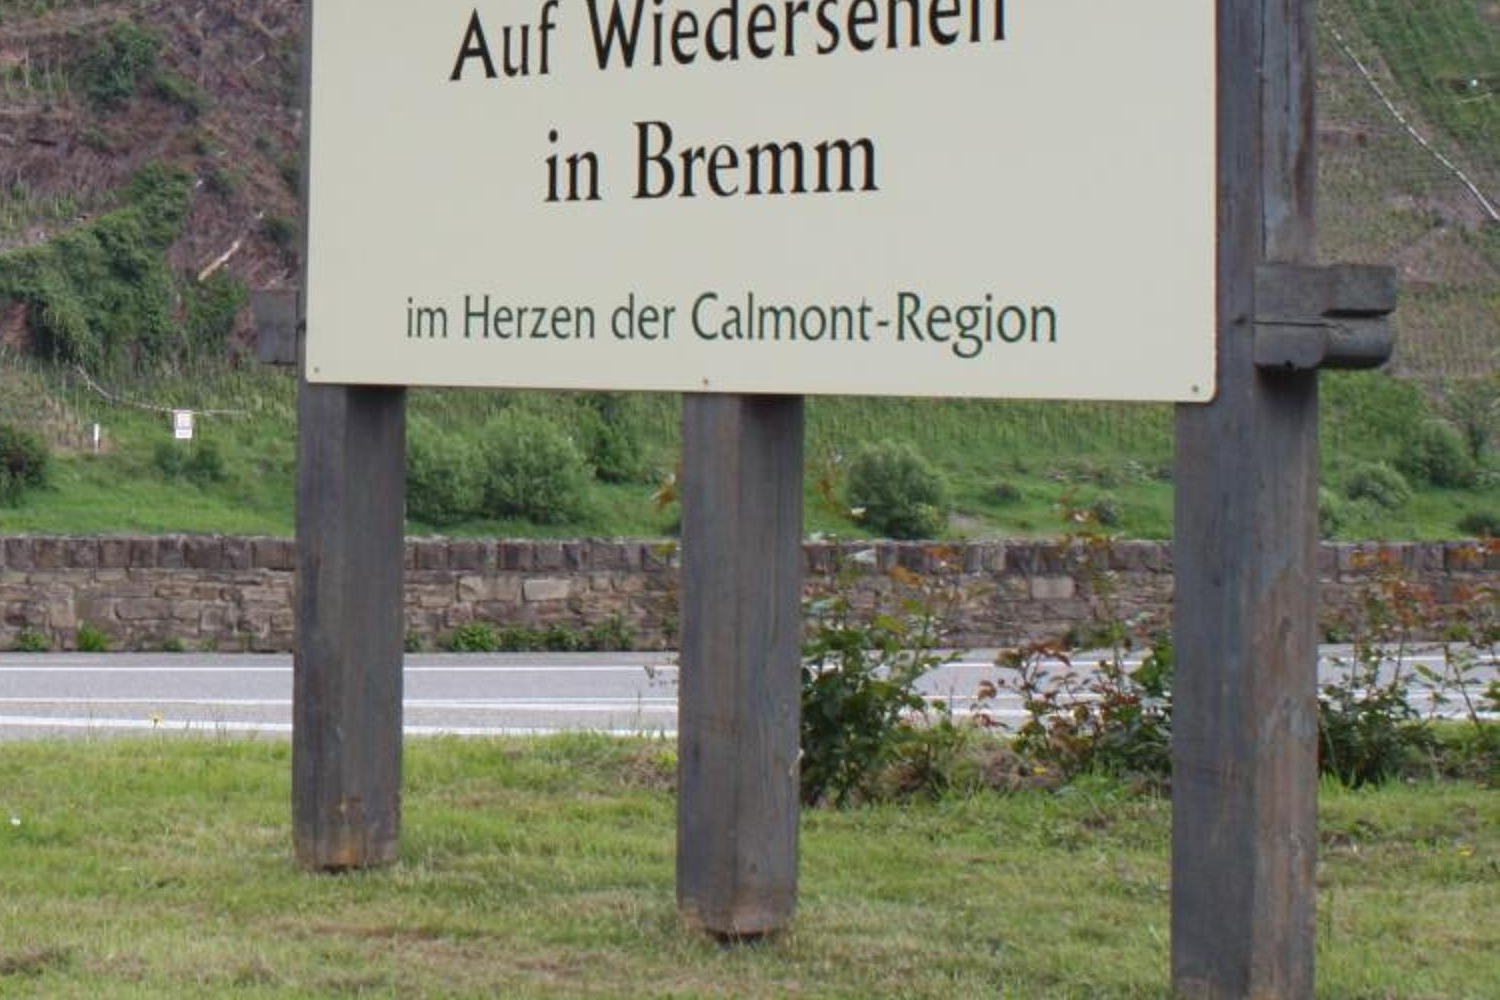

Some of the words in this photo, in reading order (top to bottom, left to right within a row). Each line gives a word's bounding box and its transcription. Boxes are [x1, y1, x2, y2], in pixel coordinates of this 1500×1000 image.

[544, 129, 603, 203] in
[632, 120, 880, 200] Bremm
[406, 296, 449, 339] im
[464, 294, 596, 340] Herzen
[611, 292, 677, 342] der
[691, 291, 1058, 359] Calmont-Region
